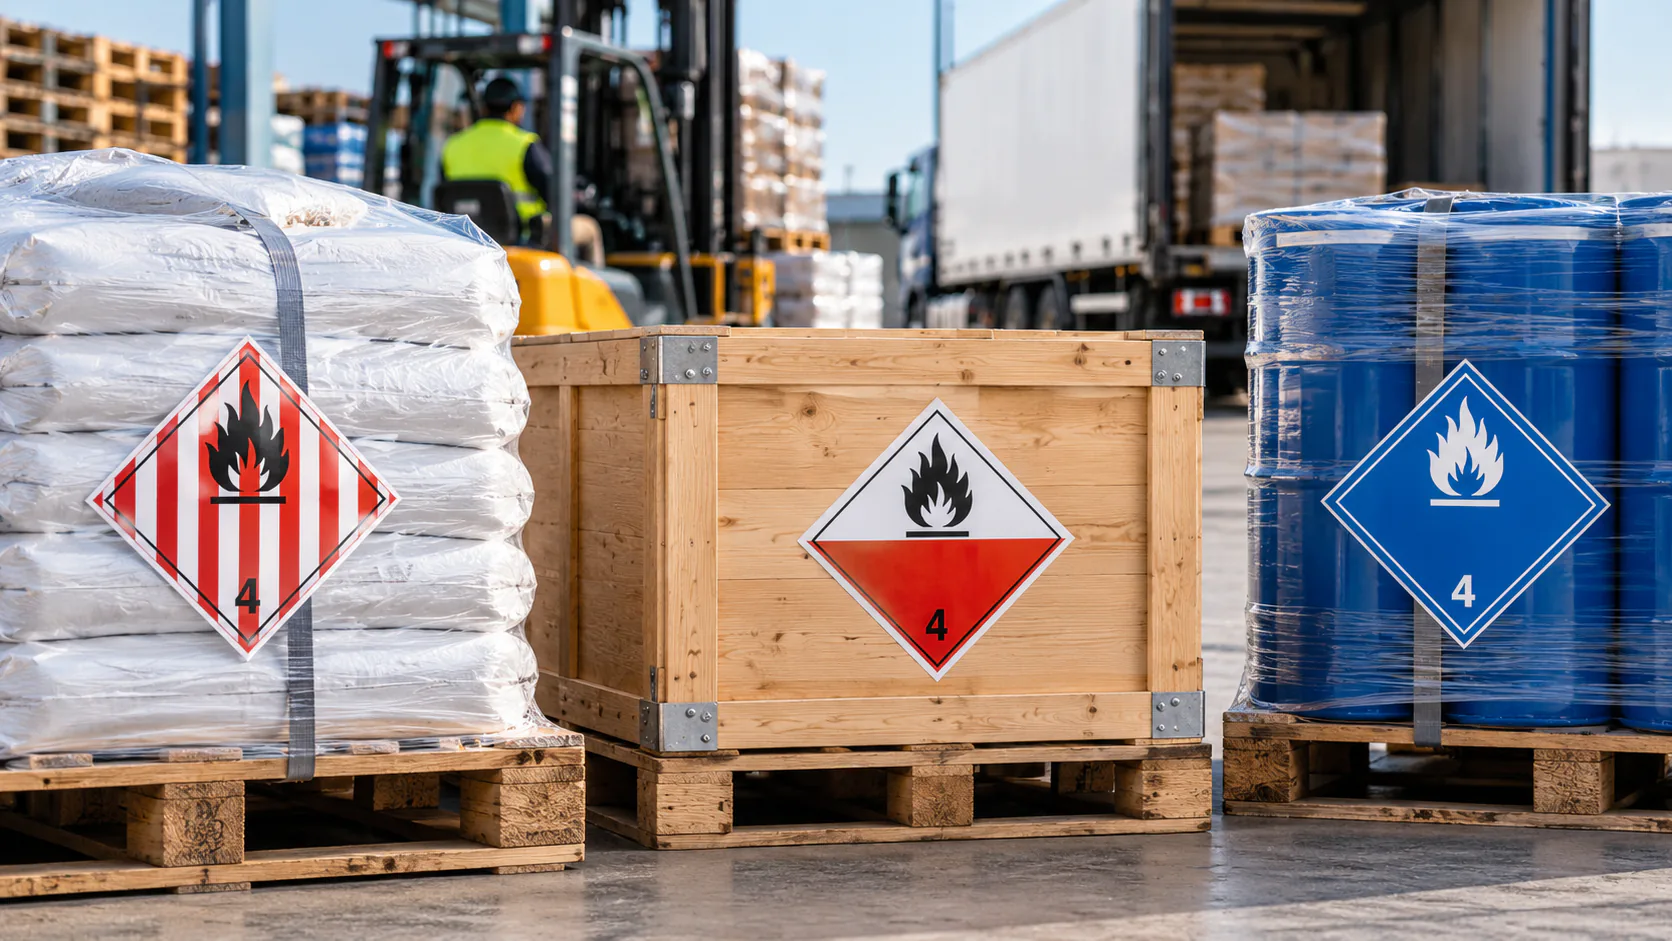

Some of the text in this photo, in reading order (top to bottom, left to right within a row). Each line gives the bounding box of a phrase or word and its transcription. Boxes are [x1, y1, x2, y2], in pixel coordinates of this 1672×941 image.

[235, 578, 261, 614] 4
[1451, 574, 1476, 608] 4
[925, 608, 948, 641] 4
